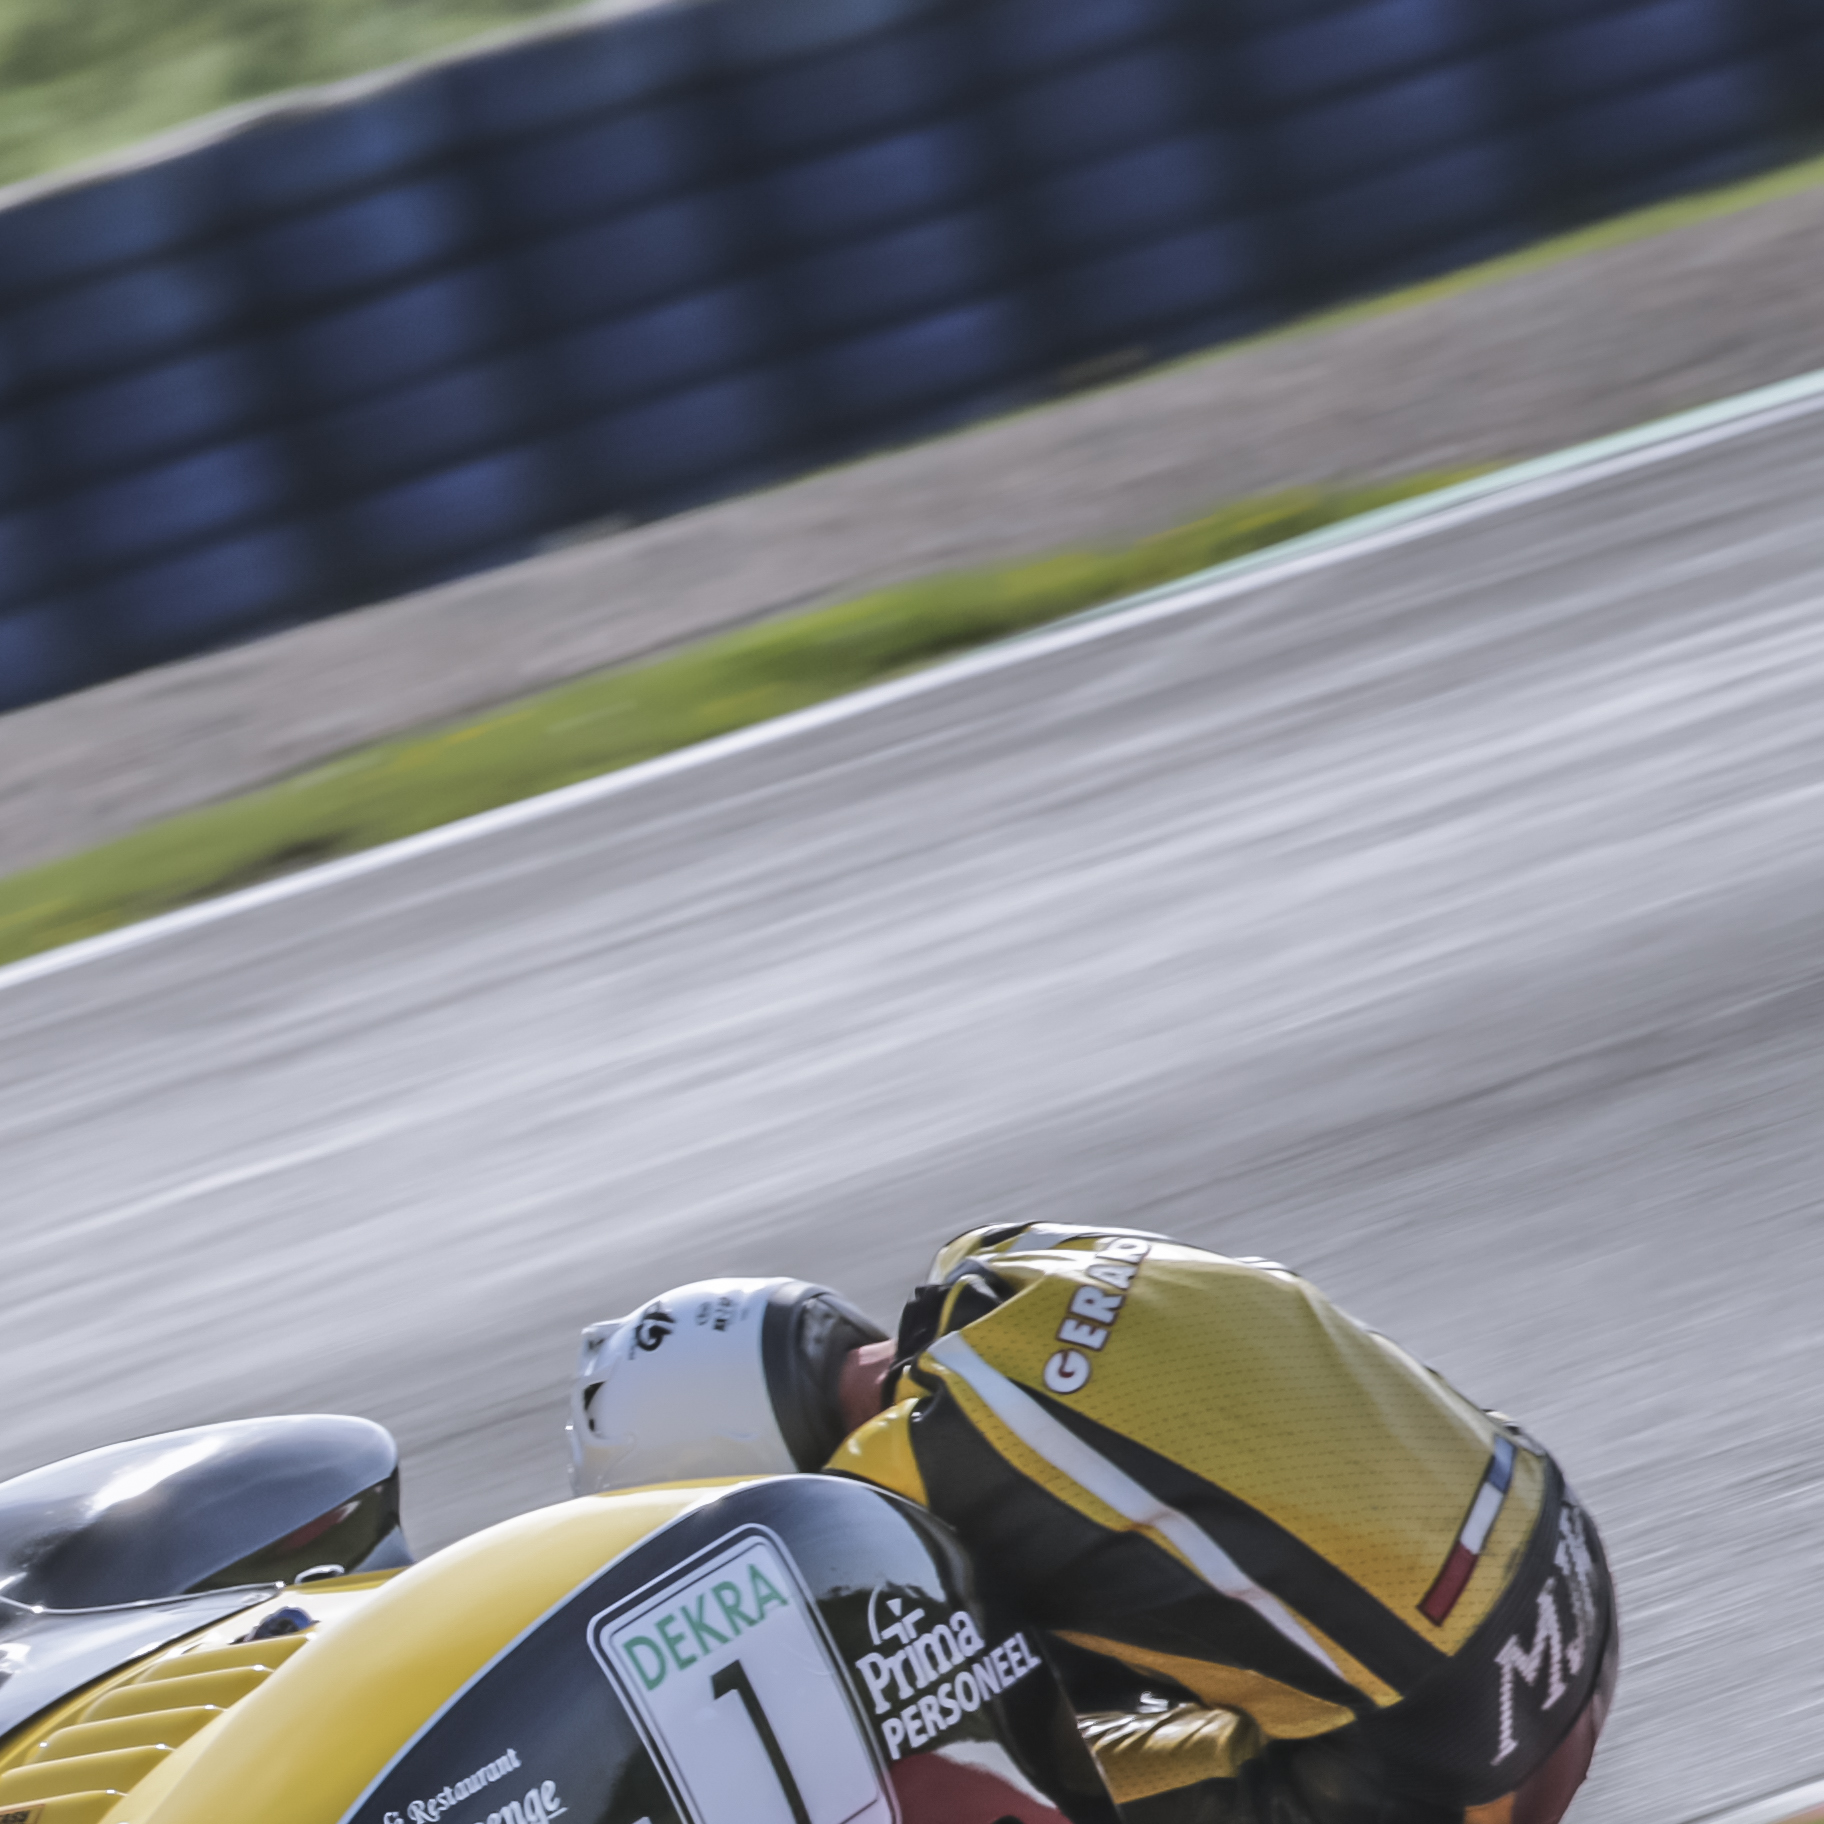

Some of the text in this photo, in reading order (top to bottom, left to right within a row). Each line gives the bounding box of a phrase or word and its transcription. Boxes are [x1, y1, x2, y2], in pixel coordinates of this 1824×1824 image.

[623, 1563, 789, 1691] DEKRA
[855, 1611, 985, 1715] Prima
[881, 1632, 1042, 1760] PERSONEEL
